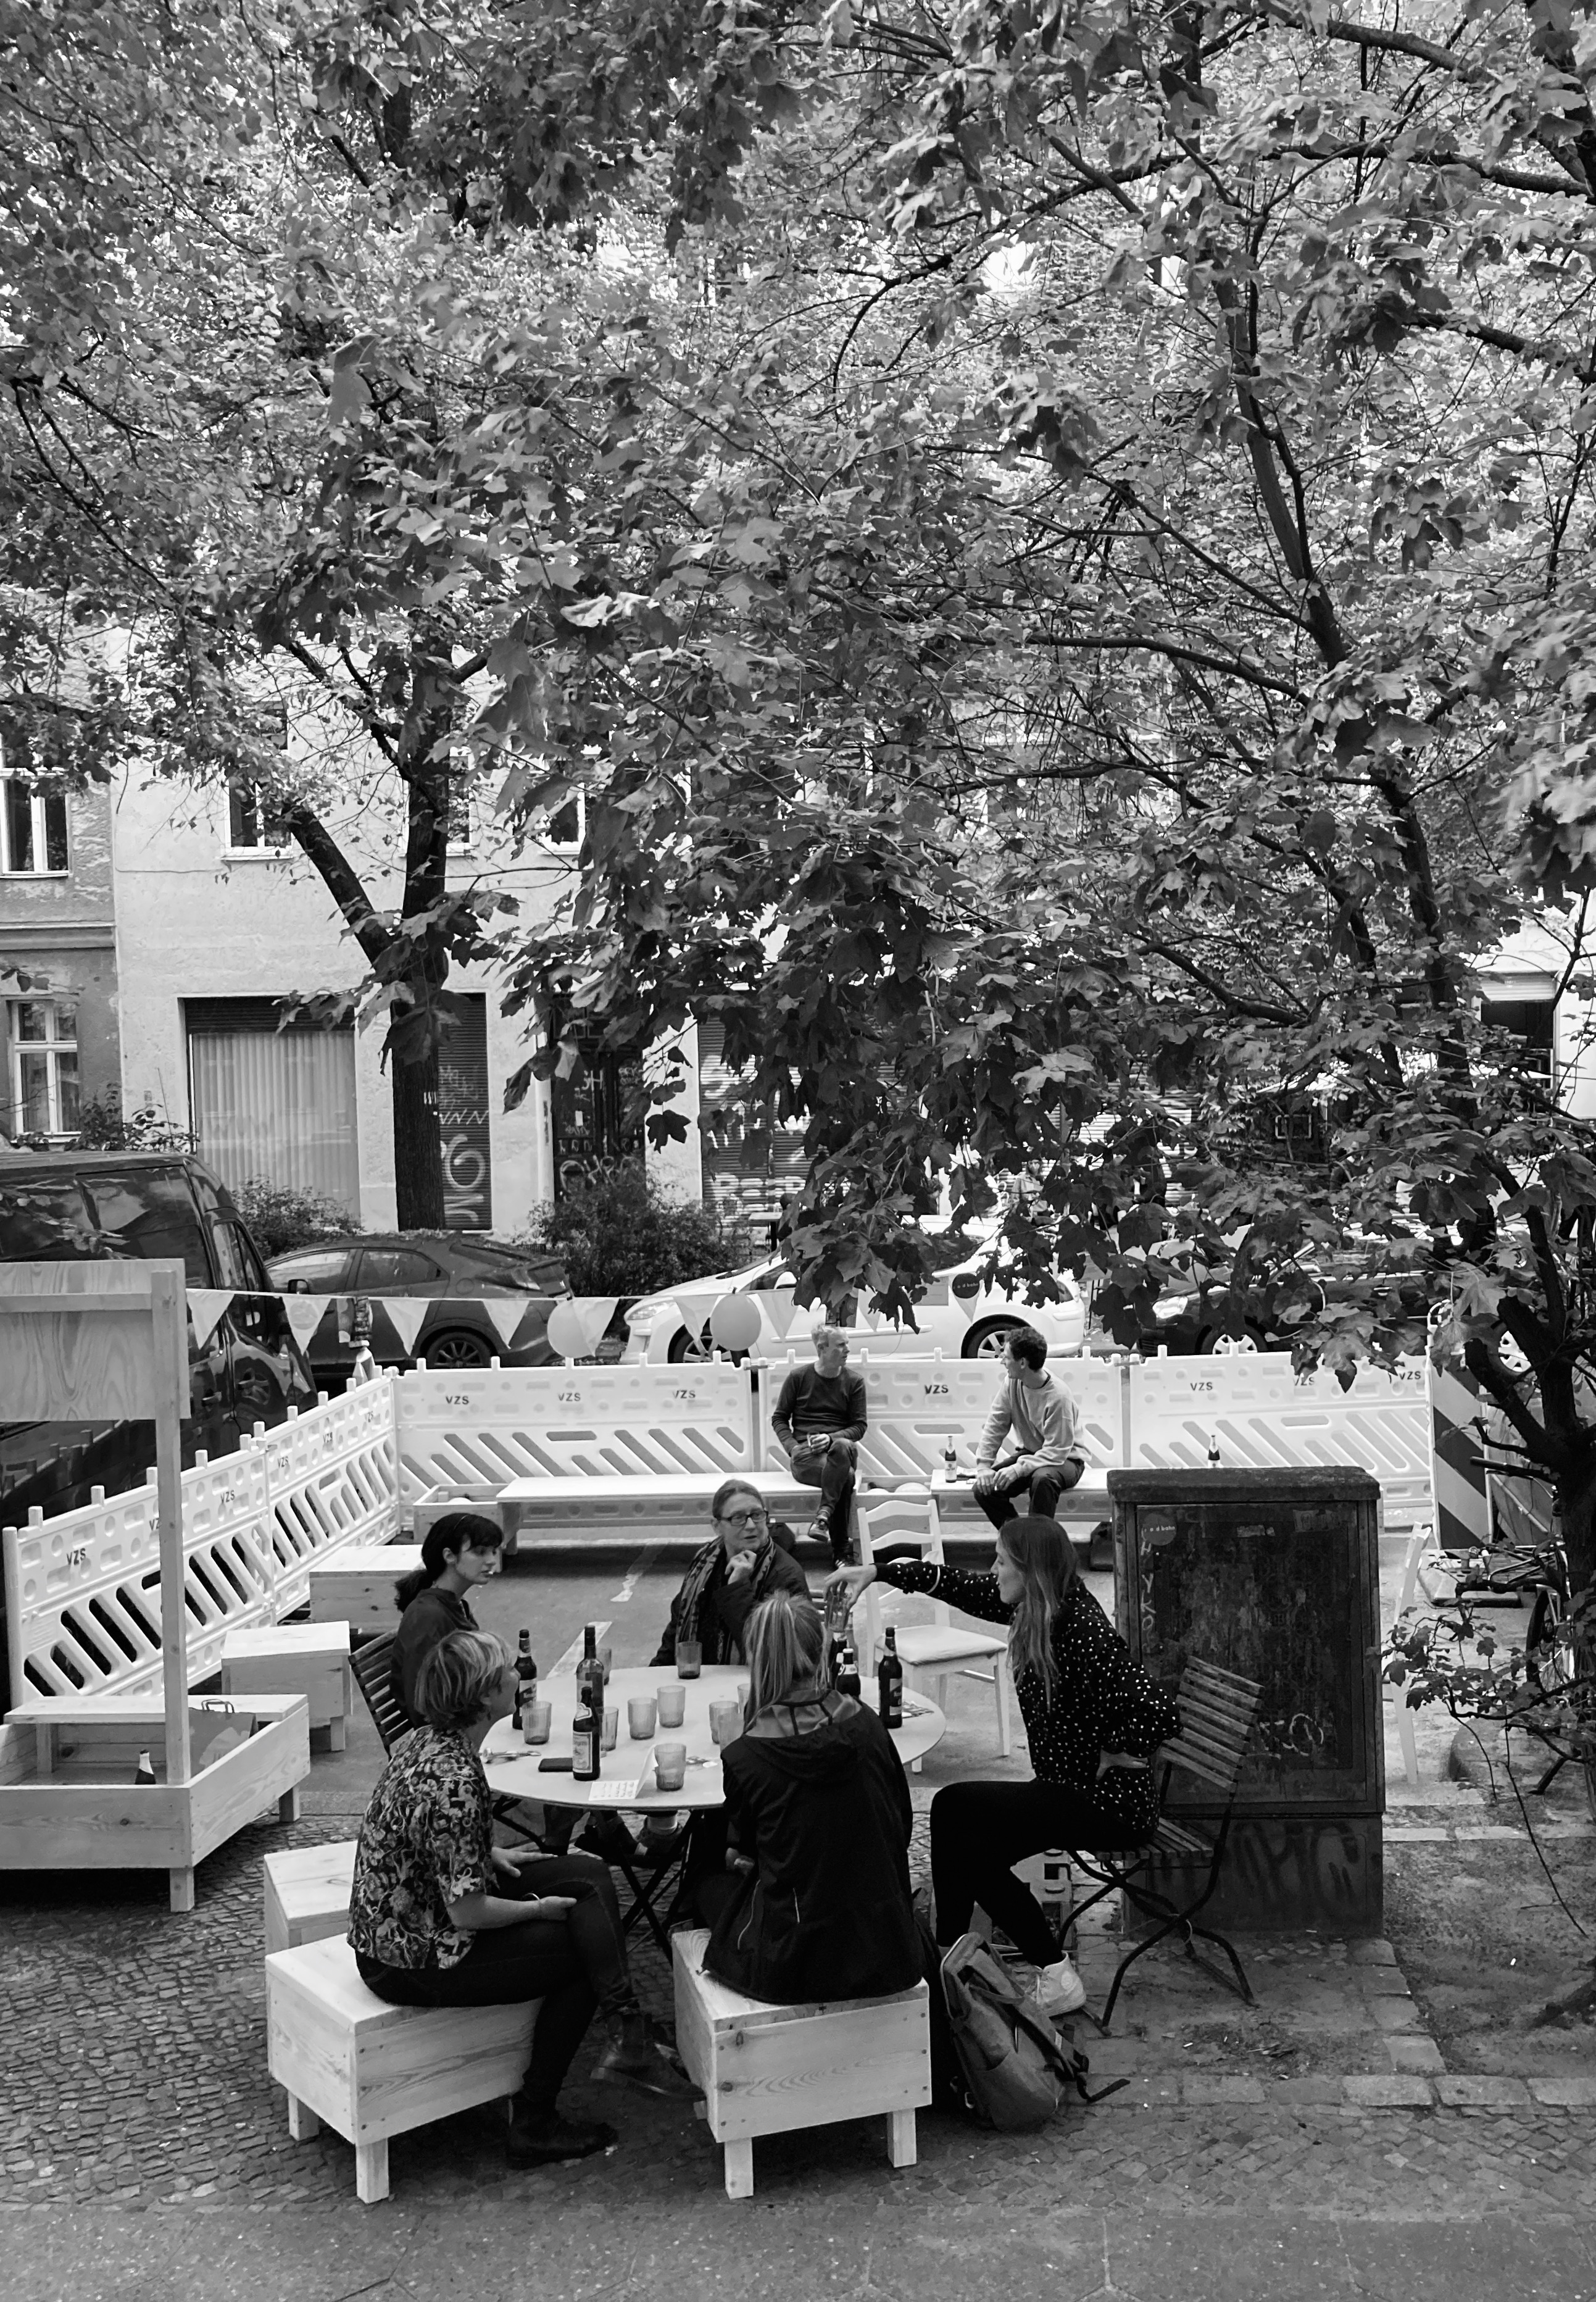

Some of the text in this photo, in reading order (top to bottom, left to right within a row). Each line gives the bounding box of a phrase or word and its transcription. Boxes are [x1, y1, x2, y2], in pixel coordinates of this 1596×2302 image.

[1399, 1371, 1421, 1380] VZS
[924, 1385, 948, 1394] VZS
[1190, 1382, 1212, 1391] VZS
[559, 1392, 581, 1401] VZS
[673, 1390, 695, 1399] VZS
[446, 1395, 469, 1405] VZS
[277, 1456, 289, 1467] VZS
[220, 1490, 235, 1503] VZS
[67, 1548, 86, 1566] VZS
